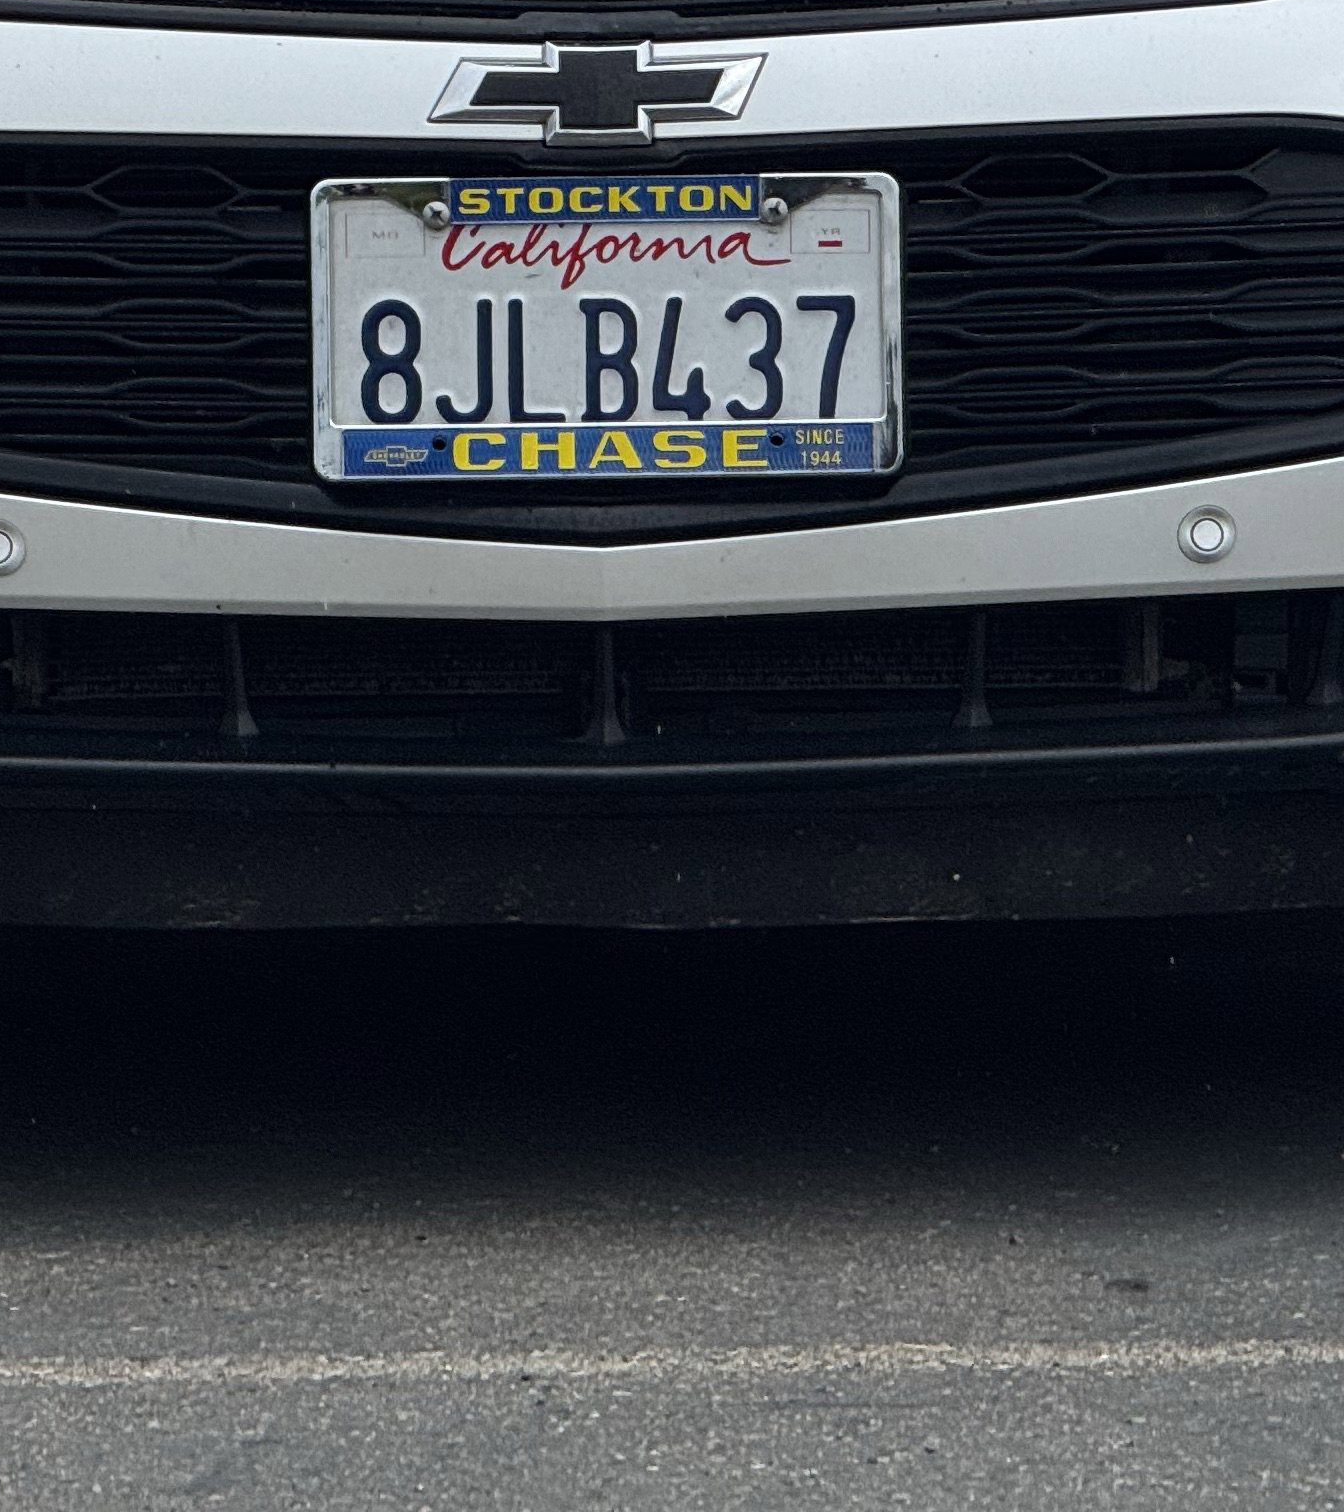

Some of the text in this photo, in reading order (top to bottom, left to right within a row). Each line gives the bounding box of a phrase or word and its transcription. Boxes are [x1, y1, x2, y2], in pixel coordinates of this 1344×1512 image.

[457, 184, 754, 215] STOCKTON
[441, 222, 793, 290] California
[360, 294, 856, 424] 8JLB437
[451, 429, 770, 471] CHASE
[795, 429, 845, 447] SINCE
[801, 450, 842, 467] 1944
